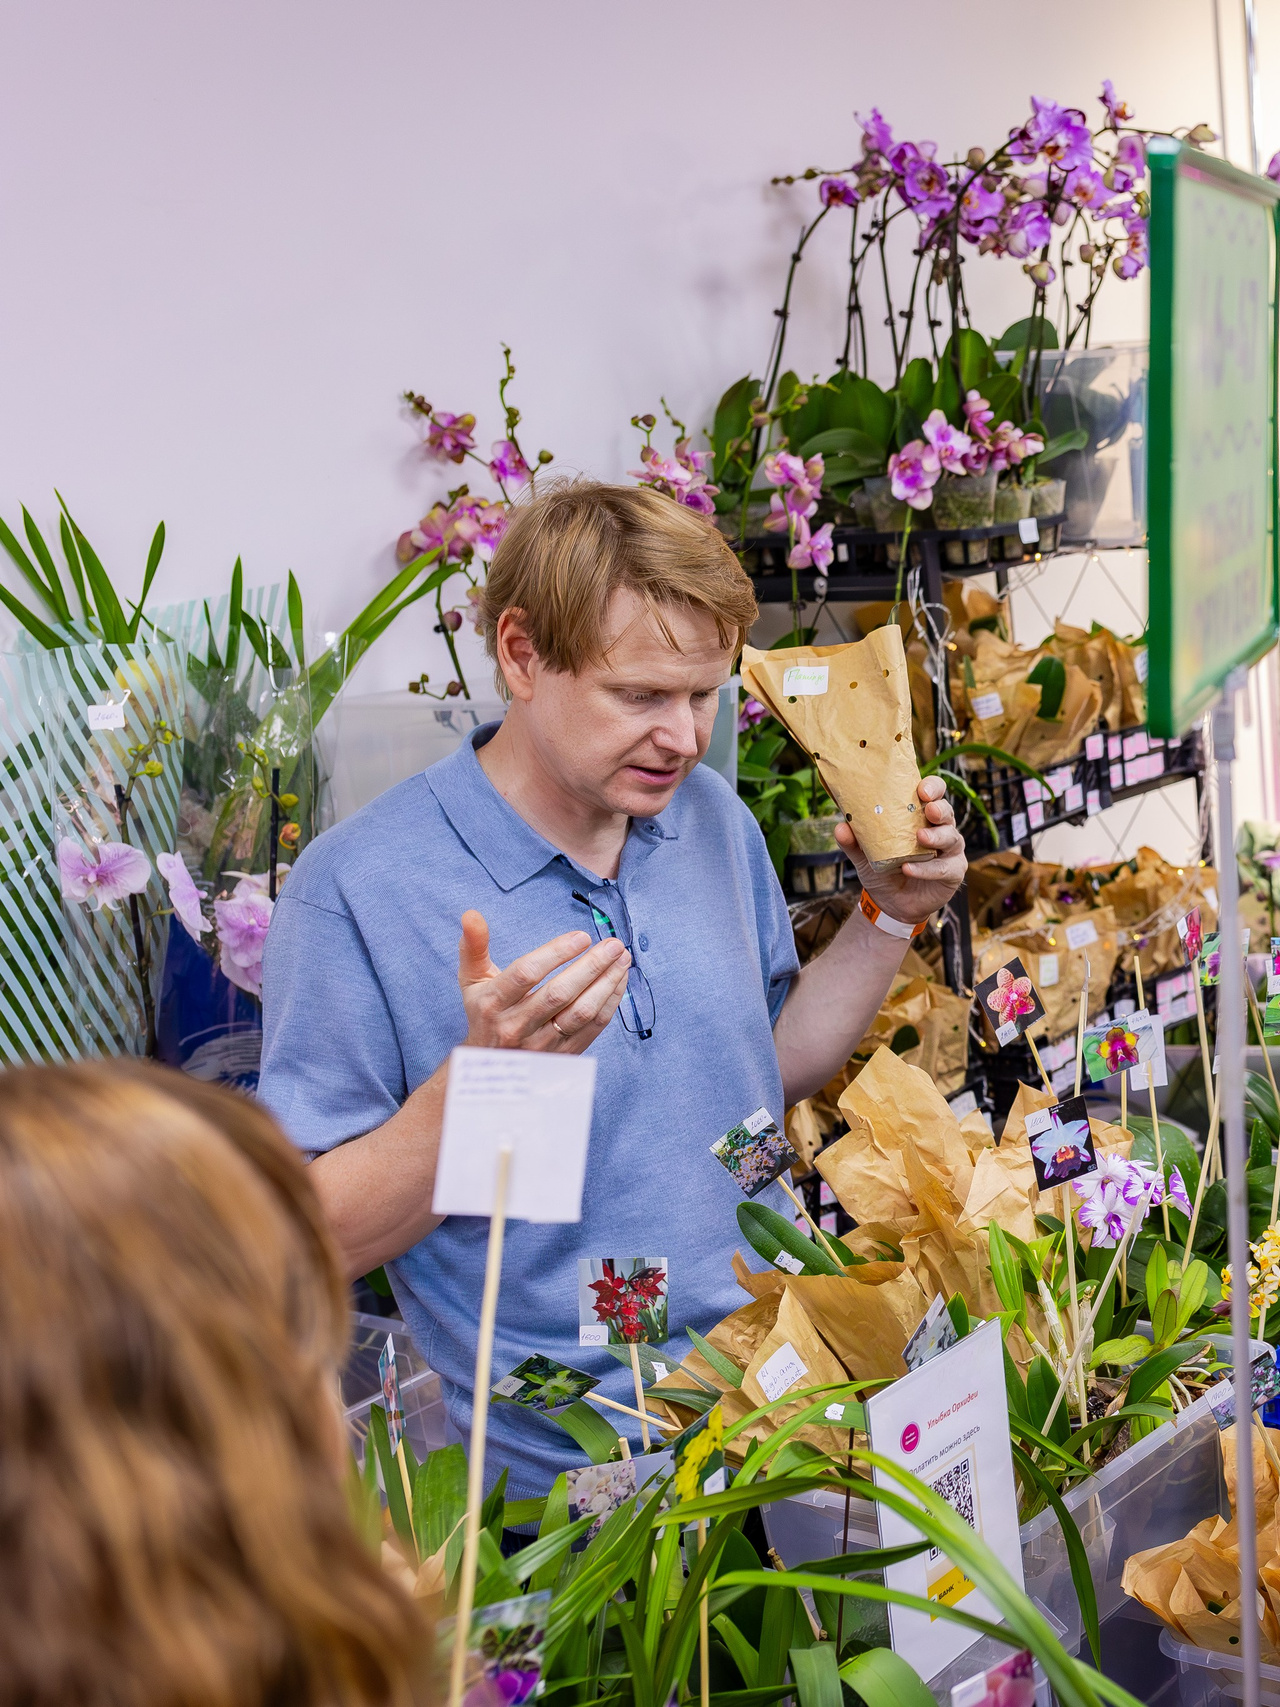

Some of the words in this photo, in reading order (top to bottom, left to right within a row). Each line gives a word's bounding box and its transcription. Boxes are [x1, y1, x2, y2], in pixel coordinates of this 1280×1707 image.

[581, 1333, 600, 1341] 1600
[927, 1409, 951, 1430] Улыбка
[951, 1390, 979, 1412] Орхидеи
[939, 1437, 962, 1457] можно
[962, 1425, 980, 1441] здесь
[938, 1583, 955, 1600] БАНК
